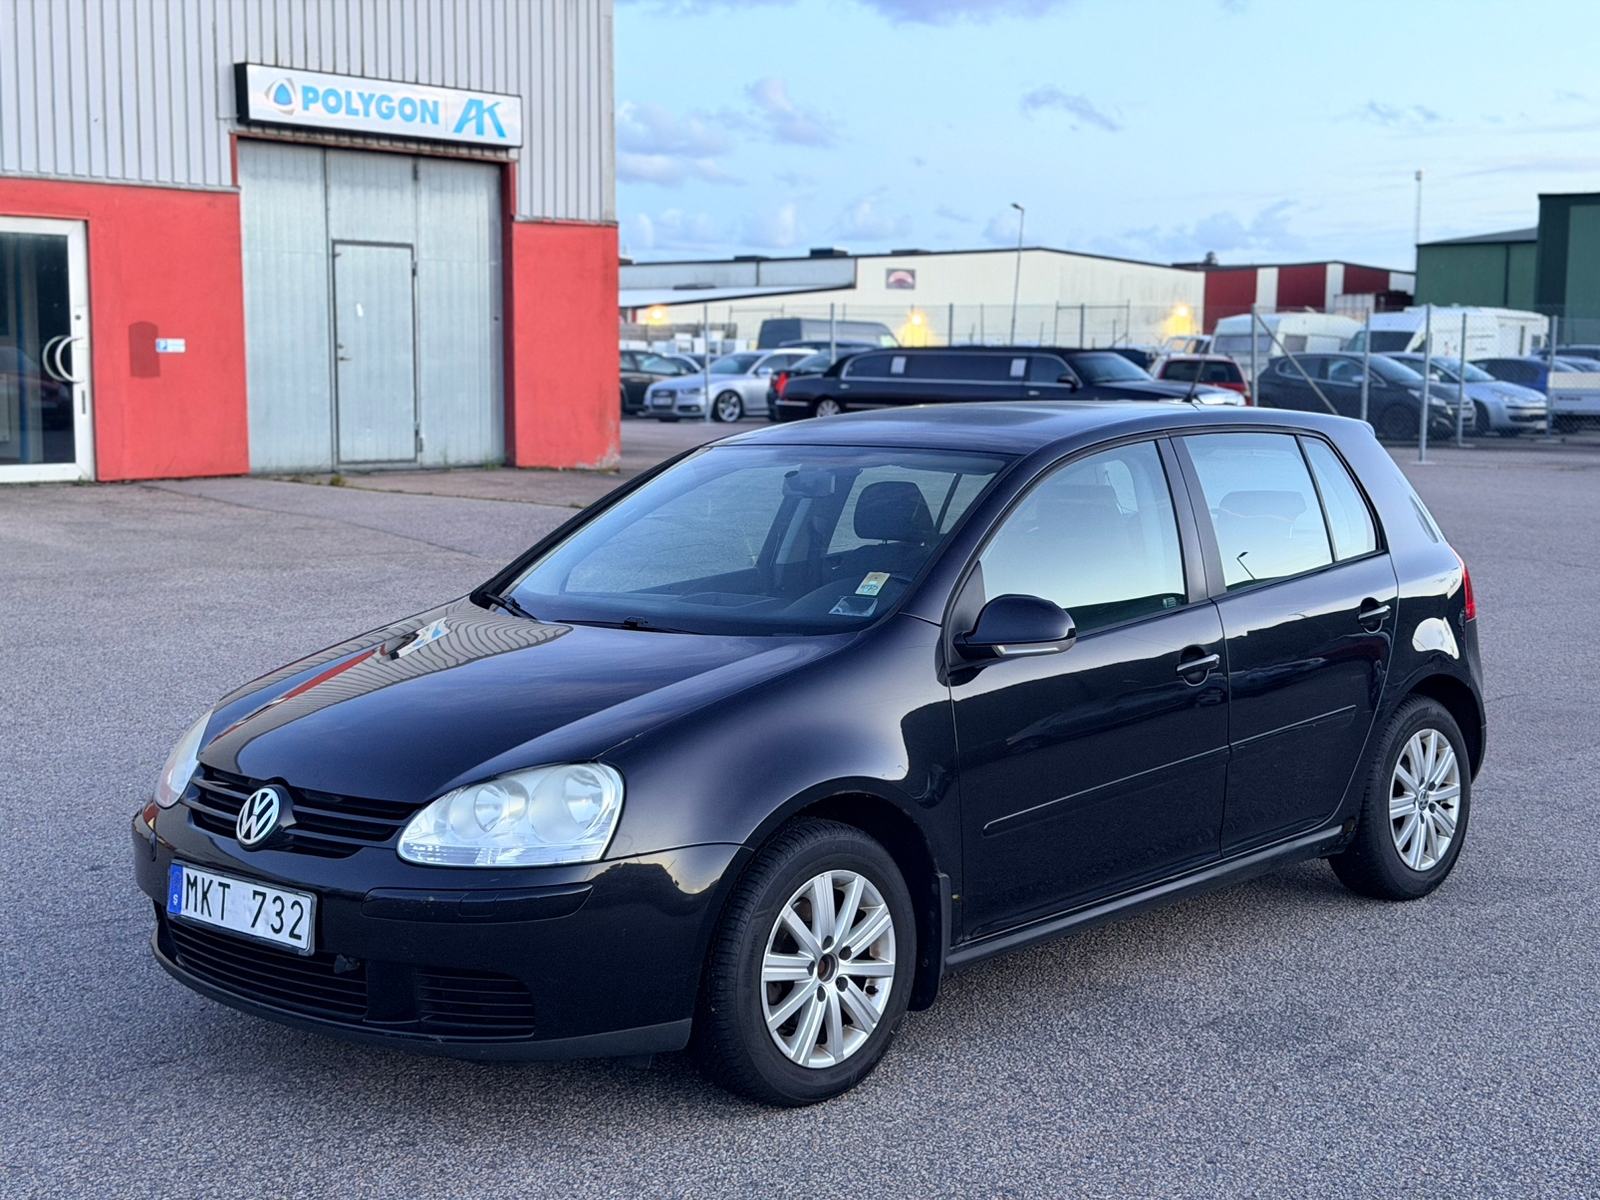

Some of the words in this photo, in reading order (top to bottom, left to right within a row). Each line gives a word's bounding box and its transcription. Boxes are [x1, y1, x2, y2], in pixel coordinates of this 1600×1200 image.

[302, 85, 440, 125] POLYGON
[453, 98, 507, 138] AK
[185, 872, 231, 922] MKT
[250, 889, 304, 941] 732
